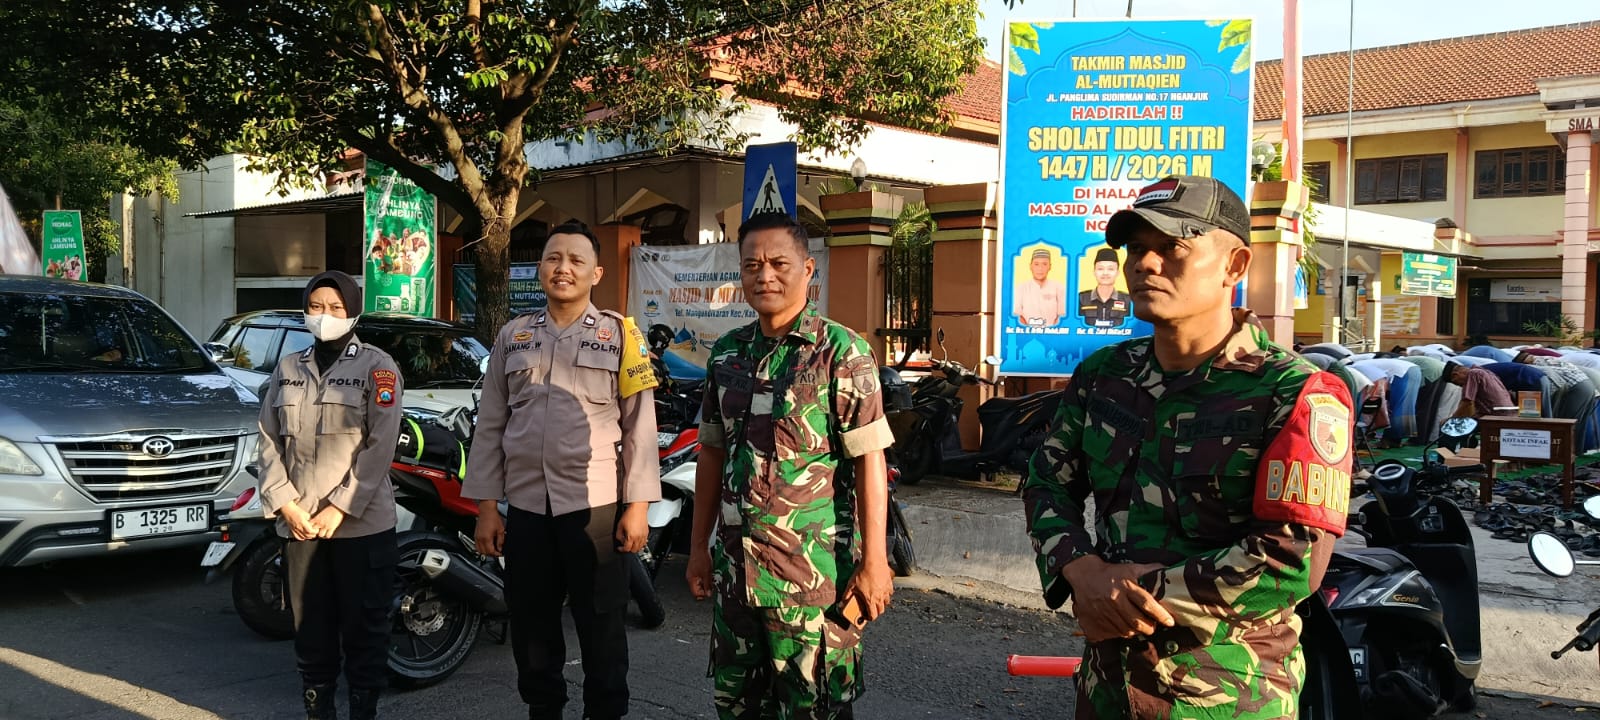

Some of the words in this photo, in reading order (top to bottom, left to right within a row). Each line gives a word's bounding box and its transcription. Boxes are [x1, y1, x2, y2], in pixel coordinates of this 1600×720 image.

[1071, 56, 1125, 71] TAKMIR
[1129, 54, 1186, 70] MASJID
[1075, 73, 1181, 89] AL-MUTTAQIEN
[1046, 94, 1058, 102] JL.
[1060, 93, 1099, 102] PANGLIMA
[1102, 93, 1143, 102] SUDIRMAN
[1145, 93, 1168, 101] NO.17
[1170, 92, 1209, 101] NGANJUK
[1072, 107, 1166, 120] HADIRILAH
[1170, 106, 1183, 119] !!
[1568, 118, 1593, 131] SMA
[1028, 126, 1110, 151] SHOLAT
[1114, 126, 1164, 150] IDUL
[1168, 126, 1225, 150] FITRI
[1038, 155, 1088, 180] 1447
[1091, 155, 1108, 179] H
[1111, 155, 1125, 180] /
[1127, 155, 1187, 179] 2026
[1191, 155, 1213, 178] M
[1074, 188, 1090, 199] DI
[1095, 188, 1142, 199] HALA
[1030, 204, 1087, 215] MASJID
[1092, 204, 1112, 215] AL
[674, 272, 718, 282] KEMENTERIAN
[668, 287, 701, 304] MASJID
[580, 340, 619, 355] POLRI
[327, 378, 366, 388] POLRI
[1266, 460, 1350, 517] BABIN
[115, 513, 125, 529] B
[140, 509, 178, 527] 1325
[186, 506, 204, 522] RR
[1392, 594, 1420, 603] Genio
